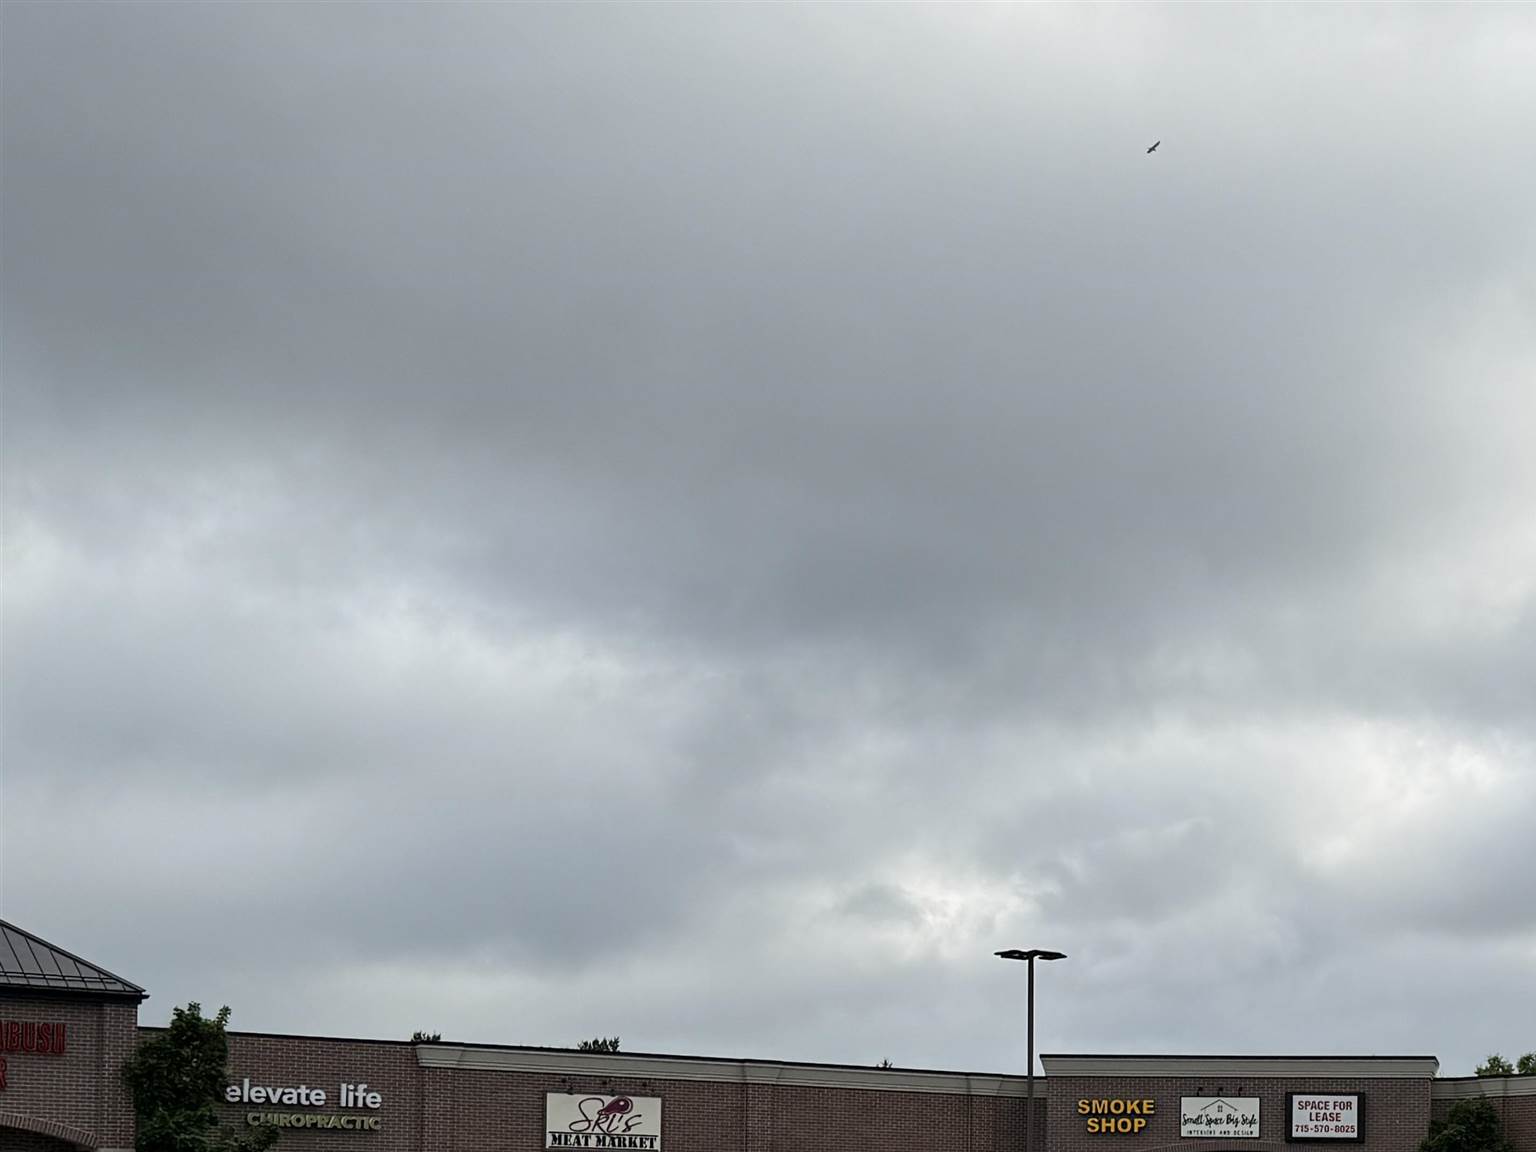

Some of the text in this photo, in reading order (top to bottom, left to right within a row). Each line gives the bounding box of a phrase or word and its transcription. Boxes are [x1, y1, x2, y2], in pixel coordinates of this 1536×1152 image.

[225, 1078, 382, 1109] elevate life
[1077, 1099, 1155, 1115] SMOKE
[1298, 1101, 1352, 1111] SPACE FOR
[247, 1112, 383, 1130] CHIROPRACTIC
[1226, 1113, 1240, 1128] Big
[1309, 1112, 1341, 1122] LEASE
[1087, 1117, 1146, 1133] SHOP
[1295, 1124, 1356, 1133] 715-570-8025
[551, 1134, 657, 1149] MEAT MARKET
